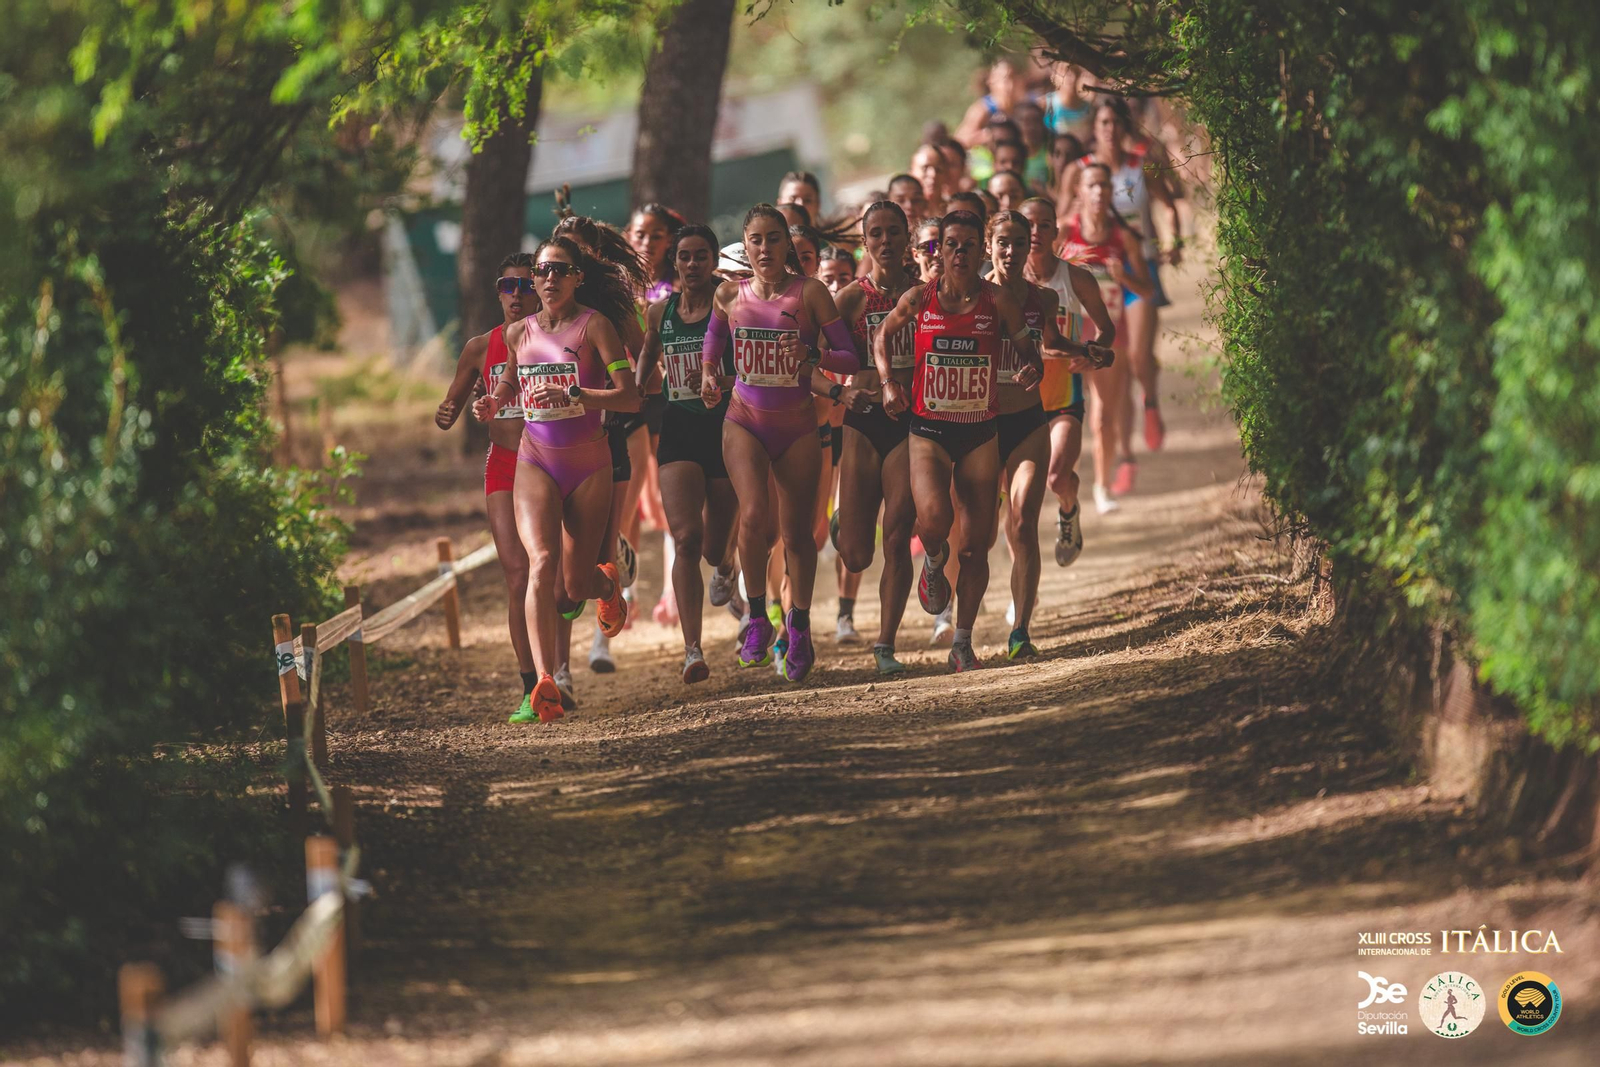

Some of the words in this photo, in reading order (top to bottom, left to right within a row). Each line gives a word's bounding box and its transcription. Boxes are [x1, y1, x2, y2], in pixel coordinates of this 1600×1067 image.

[951, 340, 975, 351] BM
[735, 339, 797, 376] FORERO
[943, 356, 974, 366] ITÁLICA
[925, 365, 988, 400] ROBLES
